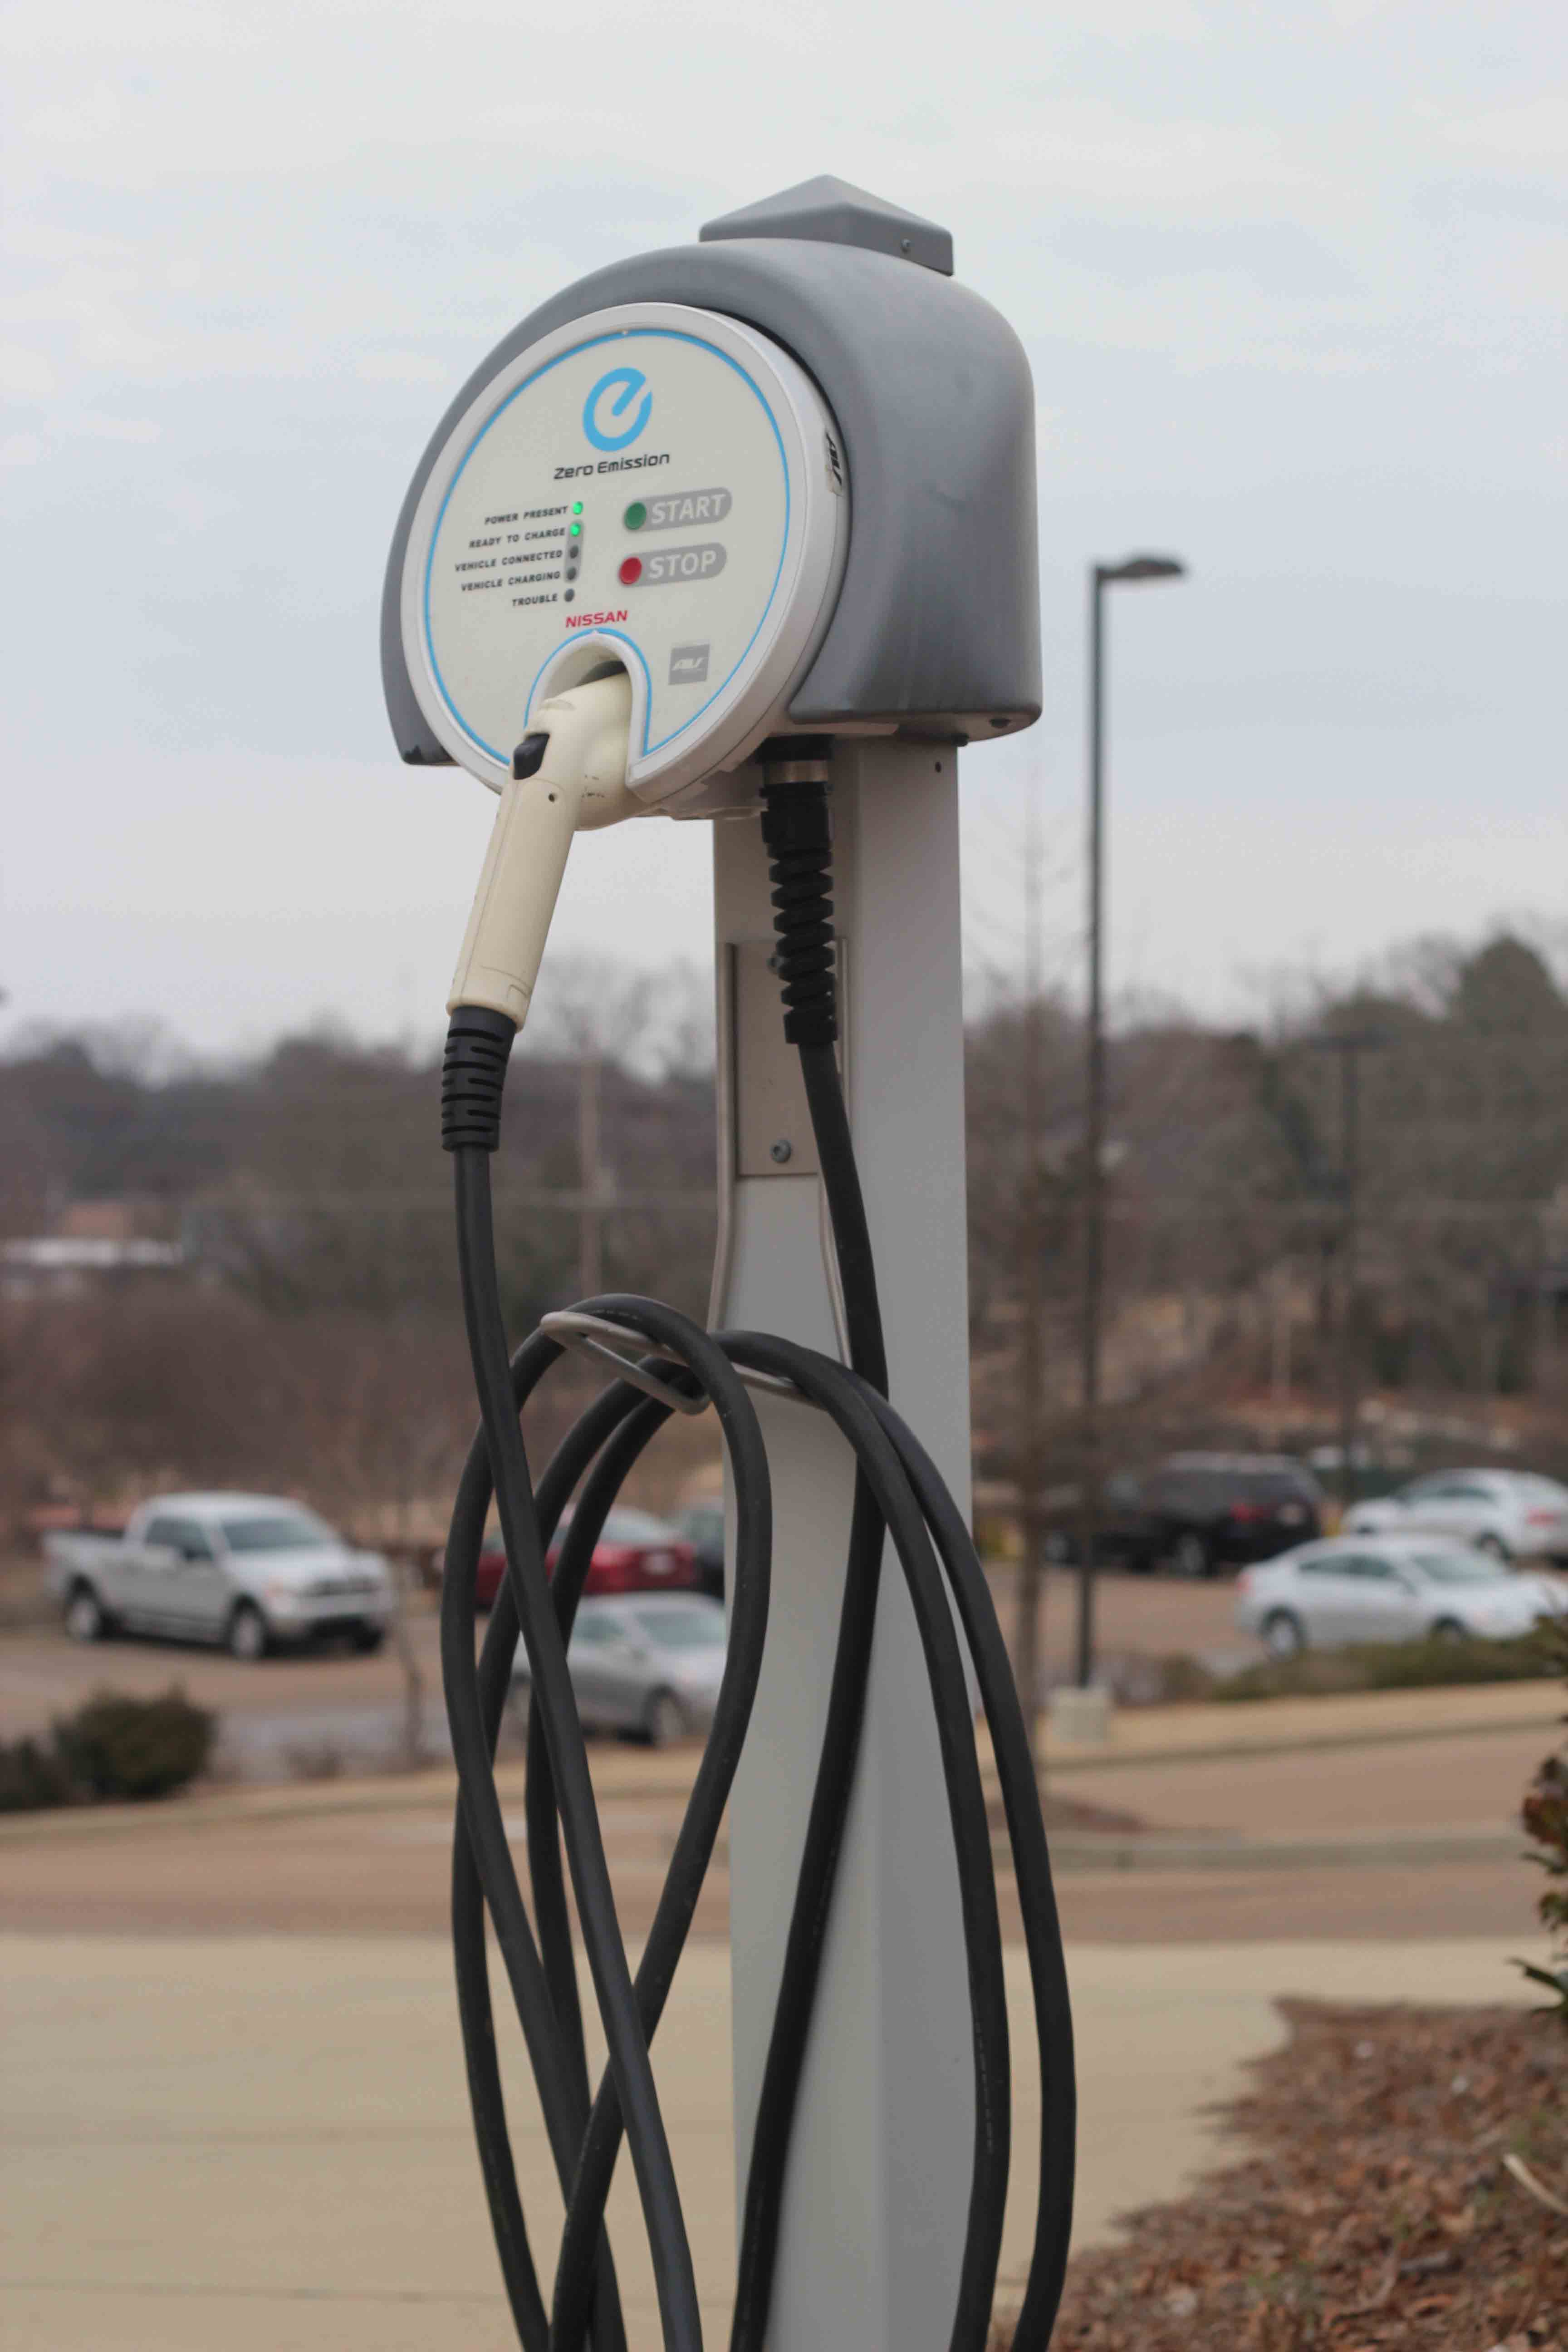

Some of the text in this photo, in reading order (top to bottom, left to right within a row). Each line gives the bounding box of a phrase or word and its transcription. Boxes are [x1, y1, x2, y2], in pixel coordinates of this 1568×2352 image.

[554, 454, 670, 480] Zero Emission
[484, 505, 568, 525] POWER PRESENT
[651, 494, 726, 524] START
[469, 527, 566, 548] READY TO CHARGE
[455, 550, 563, 572] VEHICLE CONNECTED
[648, 550, 716, 579] STOP
[461, 571, 561, 591] VEHICLE CHARGING
[512, 593, 558, 607] TROUBLE
[565, 610, 628, 628] NISSAN
